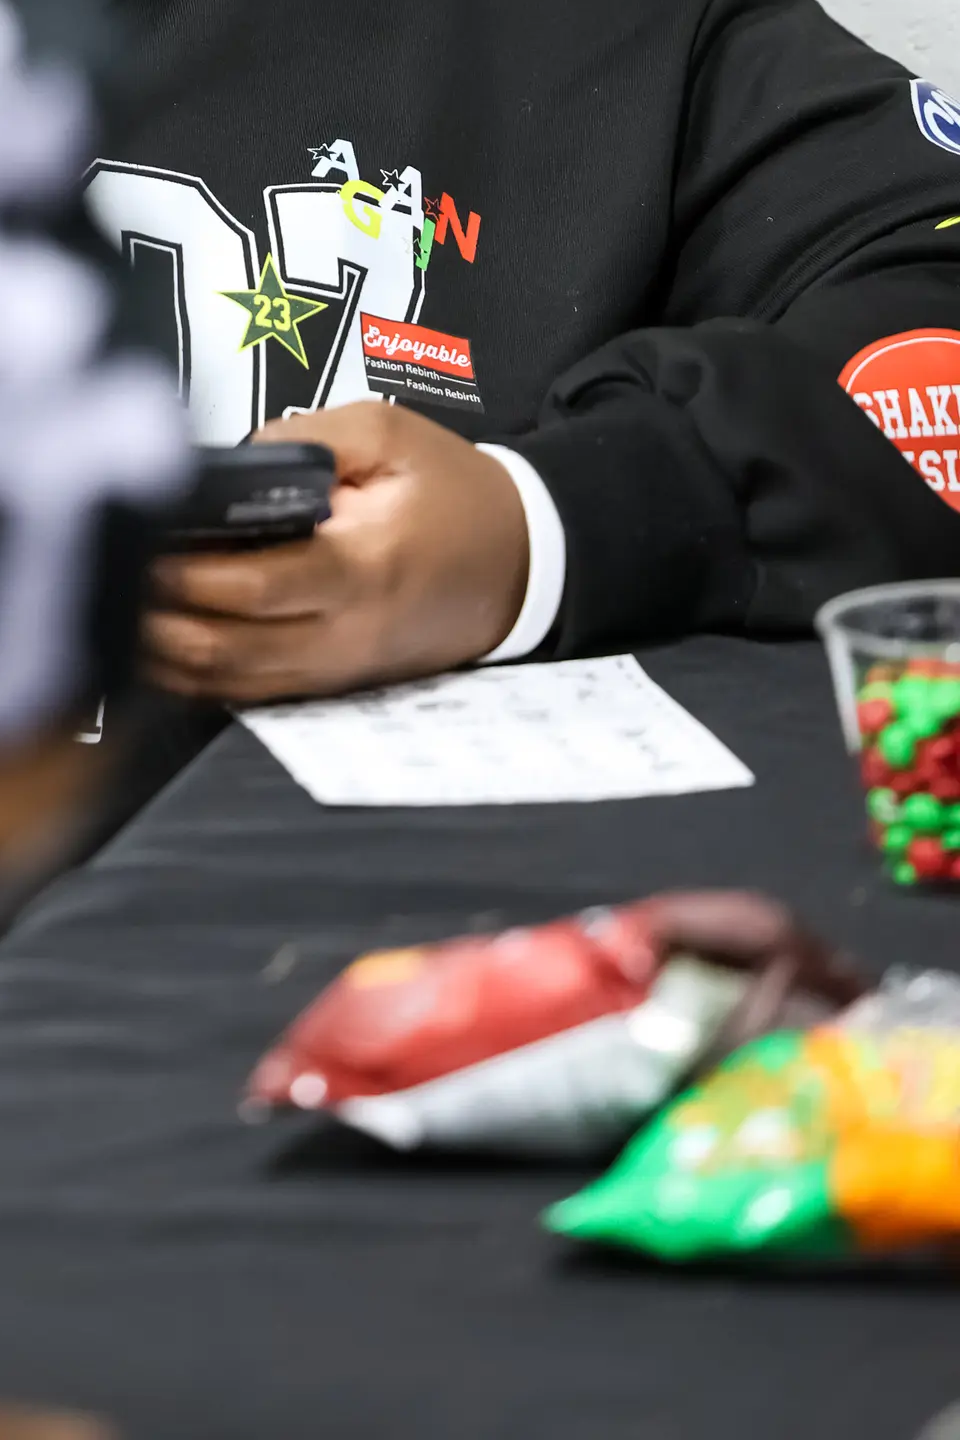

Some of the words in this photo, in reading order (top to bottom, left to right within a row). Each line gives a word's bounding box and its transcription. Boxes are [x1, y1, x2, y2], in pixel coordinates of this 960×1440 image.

[253, 294, 291, 332] 23
[363, 324, 471, 367] Enjoyable
[365, 356, 404, 372] Fashion
[405, 364, 440, 380] Rebirth
[406, 378, 444, 396] Fashion
[445, 387, 481, 403] Rebirth
